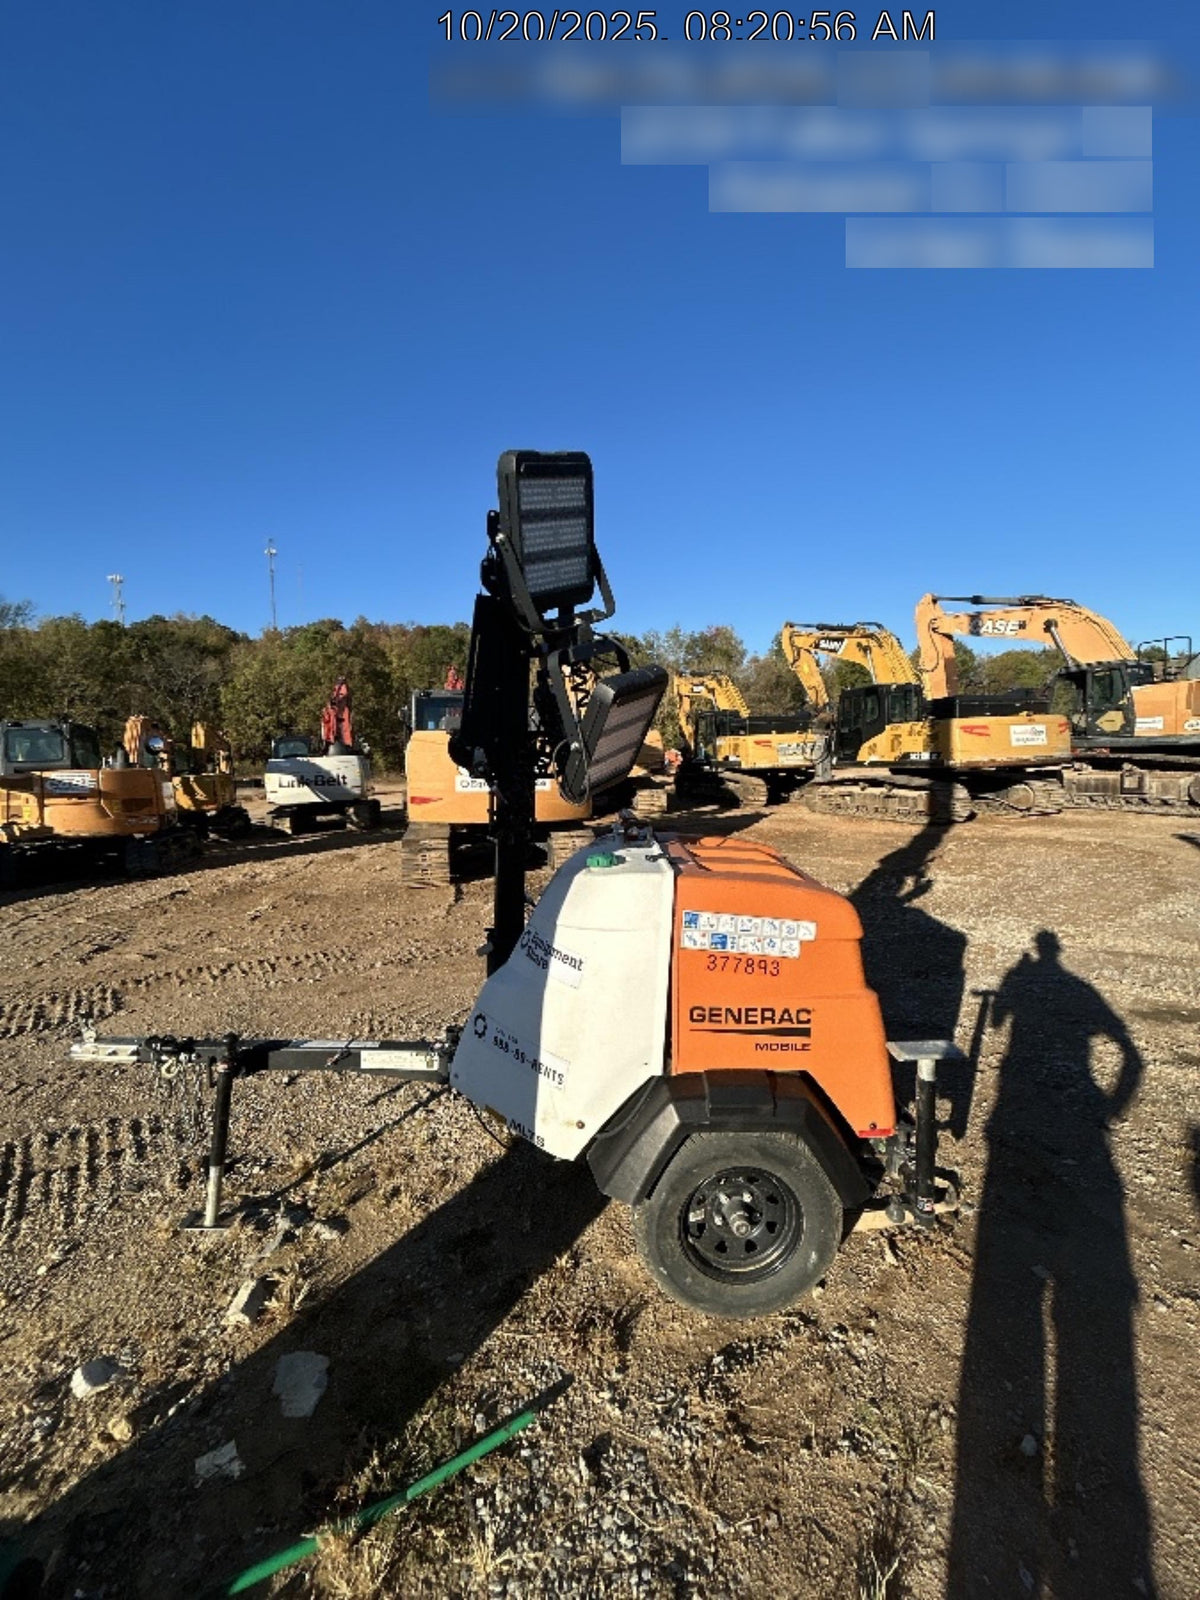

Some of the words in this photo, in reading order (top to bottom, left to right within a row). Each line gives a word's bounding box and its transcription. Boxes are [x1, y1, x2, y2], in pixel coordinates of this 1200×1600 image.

[706, 954, 780, 977] 377893
[689, 1006, 812, 1025] GENERAC
[755, 1043, 811, 1052] MOBILE
